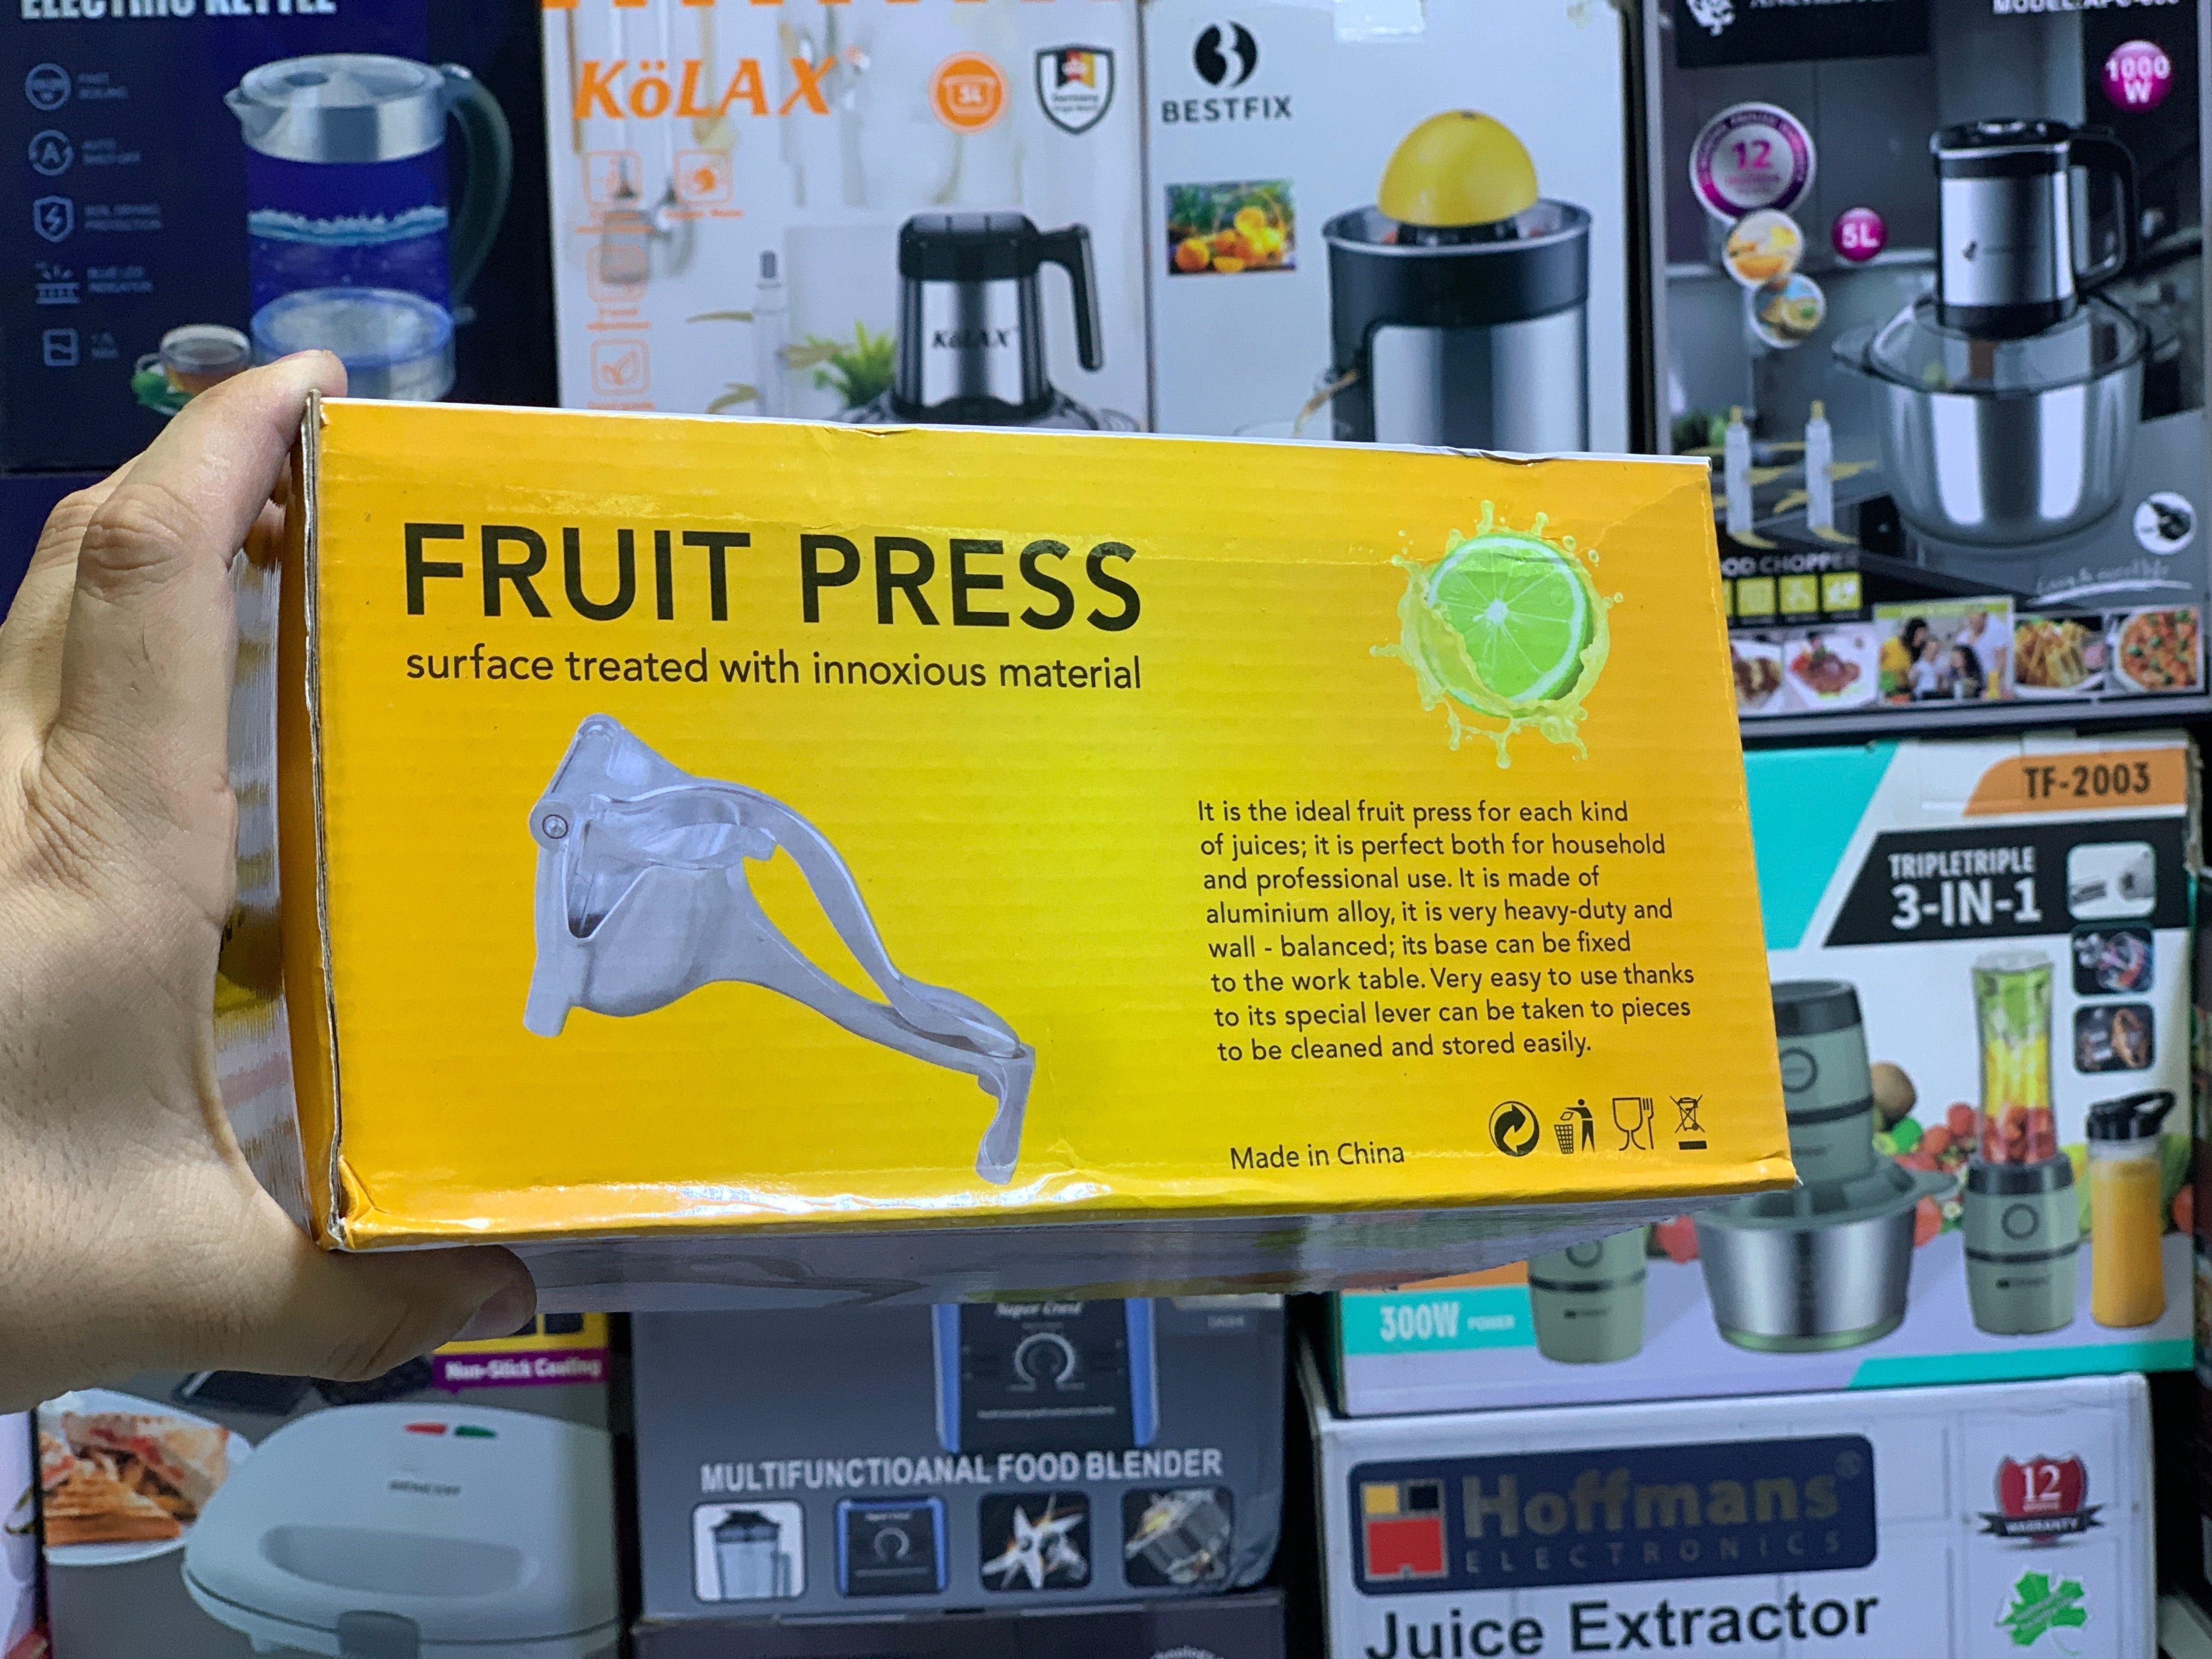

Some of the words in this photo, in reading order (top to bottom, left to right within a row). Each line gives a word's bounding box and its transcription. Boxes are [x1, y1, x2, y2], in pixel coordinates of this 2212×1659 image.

[2106, 54, 2171, 82] 1000
[574, 59, 837, 119] KöLAX
[2124, 77, 2152, 104] W
[1161, 95, 1292, 124] BESTFIX
[1731, 139, 1772, 170] 12
[1842, 222, 1880, 249] 5L
[405, 523, 751, 621] FRUIT
[800, 534, 1141, 631] PRESS
[407, 643, 554, 680] surface
[565, 647, 707, 682] treated
[719, 648, 799, 683] with
[813, 651, 986, 686] innoxious
[1000, 655, 1141, 689] material
[2023, 761, 2152, 799] TF-2003
[1199, 800, 1214, 821] It
[1223, 800, 1240, 821] is
[1248, 799, 1286, 821] the
[1296, 799, 1350, 821] ideal
[1357, 799, 1404, 821] fruit
[1413, 807, 1471, 829] press
[1478, 799, 1510, 821] for
[1520, 800, 1572, 821] each
[1581, 800, 1628, 821] kind
[1201, 833, 1223, 855] of
[1232, 834, 1306, 861] juices;
[1314, 834, 1330, 855] it
[1337, 834, 1353, 855] is
[1362, 833, 1444, 862] perfect
[1452, 833, 1504, 854] both
[1512, 832, 1544, 854] for
[1552, 832, 1665, 854] household
[1888, 845, 2035, 879] TRIPLETRIPLE
[1204, 867, 1246, 889] and
[1257, 866, 1398, 896] professional
[1408, 873, 1452, 888] use.
[1459, 867, 1475, 888] It
[1483, 867, 1499, 887] is
[1509, 865, 1570, 887] made
[1578, 865, 1599, 886] of
[1207, 901, 1328, 923] aluminium
[1338, 900, 1395, 928] alloy,
[1402, 901, 1417, 921] it
[1425, 901, 1442, 921] is
[1448, 906, 1497, 927] very
[1504, 898, 1627, 926] heavy-duty
[1634, 898, 1672, 918] and
[1891, 879, 2042, 930] 3-IN-1
[1208, 935, 1255, 957] wall
[1281, 934, 1395, 959] balanced;
[1402, 935, 1427, 955] its
[1434, 933, 1487, 954] base
[1496, 939, 1534, 953] can
[1543, 932, 1570, 952] be
[1577, 930, 1630, 952] fixed
[1211, 974, 1235, 992] to
[1243, 969, 1283, 991] the
[1291, 968, 1351, 990] work
[1358, 967, 1425, 989] table.
[1430, 967, 1482, 994] Very
[1491, 972, 1541, 992] easy
[1548, 968, 1571, 985] to
[1581, 970, 1617, 985] use
[1623, 962, 1694, 984] thanks
[1214, 1008, 1239, 1026] to
[1248, 1005, 1276, 1026] its
[1285, 1001, 1365, 1032] special
[1375, 1001, 1431, 1023] lever
[1439, 1007, 1477, 1022] can
[1486, 999, 1515, 1020] be
[1521, 997, 1584, 1019] taken
[1590, 1001, 1613, 1018] to
[1622, 997, 1690, 1024] pieces
[1217, 1043, 1242, 1061] to
[1251, 1038, 1282, 1060] be
[1291, 1035, 1383, 1059] cleaned
[1392, 1034, 1433, 1057] and
[1443, 1031, 1514, 1055] stored
[1524, 1030, 1591, 1058] easily.
[1231, 1144, 1299, 1169] Made
[1308, 1143, 1329, 1166] in
[1338, 1141, 1404, 1165] China
[1380, 1301, 1460, 1342] 300W
[701, 1454, 992, 1492] MULTIFUNCTIOANAL
[997, 1451, 1081, 1482] FOOD
[1085, 1448, 1223, 1481] BLENDER
[2022, 1465, 2062, 1501] 12
[1465, 1530, 1839, 1573] ELECTRONICS
[1364, 1609, 1544, 1659] Juice
[1570, 1591, 1879, 1652] Extractor
